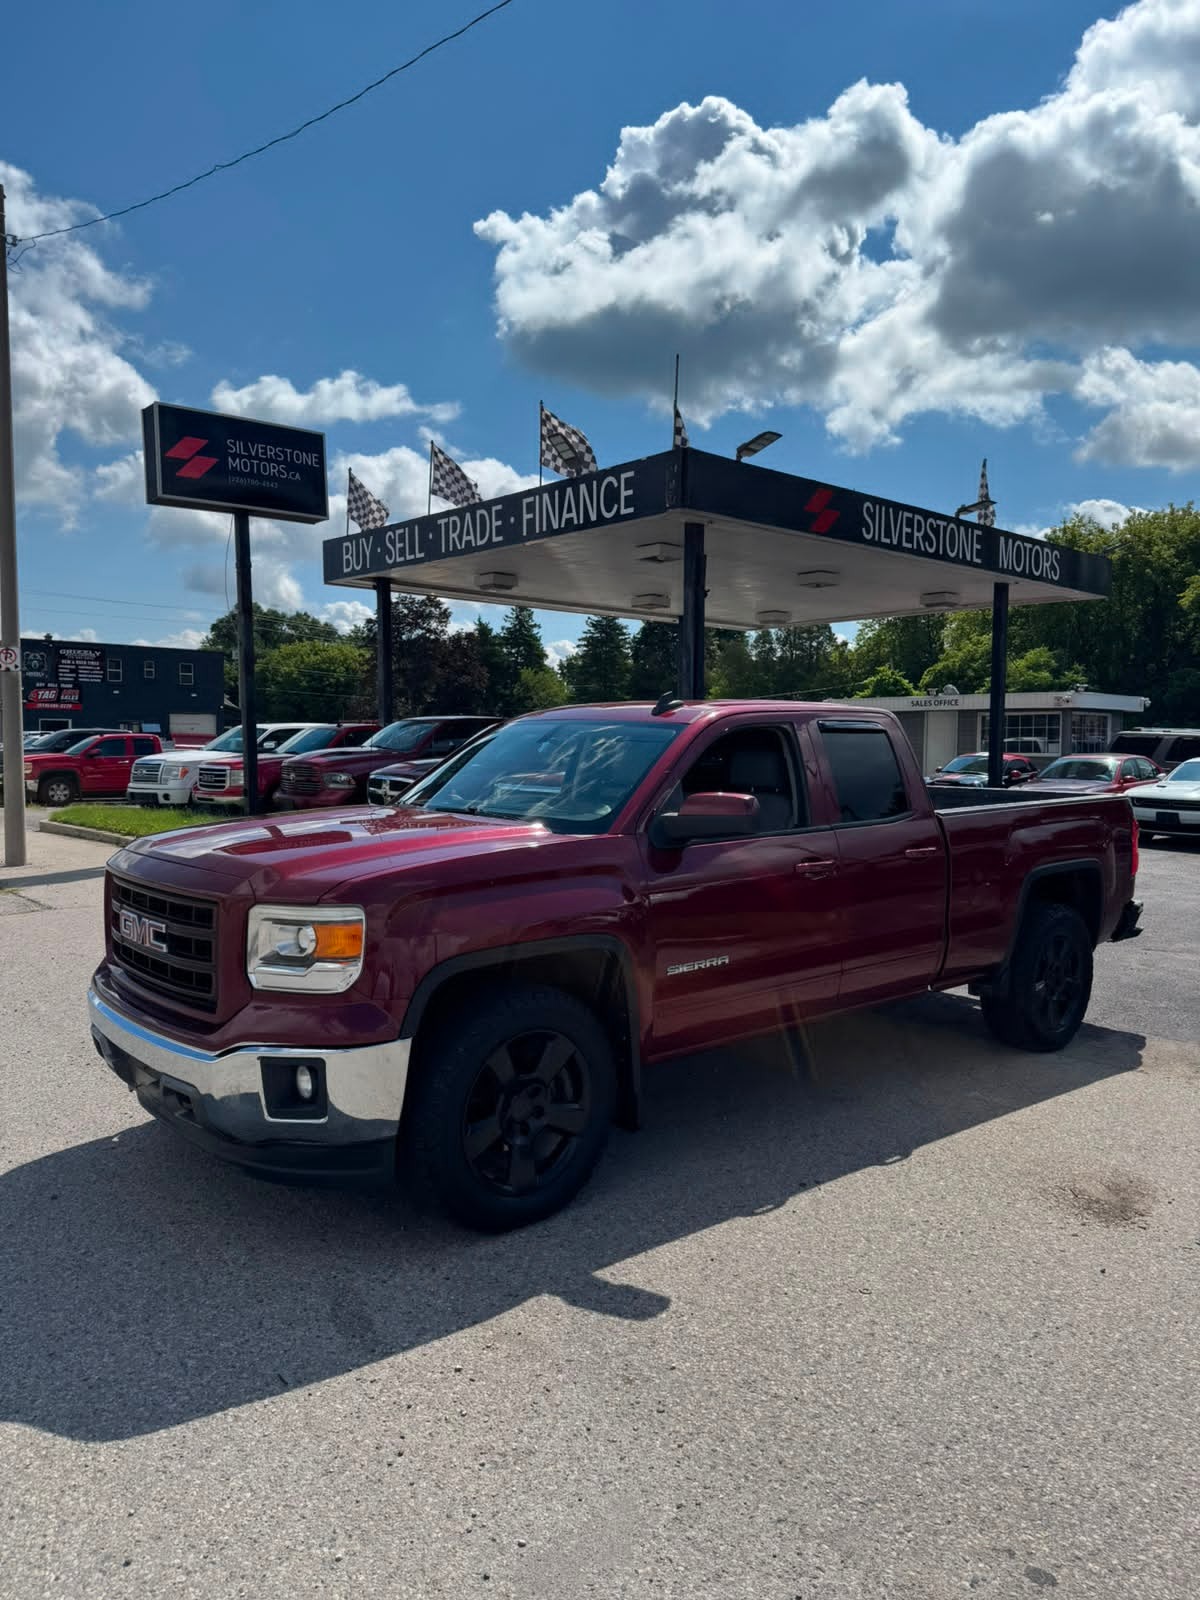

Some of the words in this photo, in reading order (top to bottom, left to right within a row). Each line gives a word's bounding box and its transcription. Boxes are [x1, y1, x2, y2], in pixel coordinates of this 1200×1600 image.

[226, 439, 321, 468] SILVERSTONE
[227, 456, 301, 481] MOTORS.CA
[342, 535, 374, 574] BUY
[385, 524, 425, 565] SELL
[437, 504, 504, 553] TRADE
[521, 470, 635, 537] FINANCE
[861, 501, 983, 564] SILVERSTONE
[999, 535, 1061, 581] MOTORS
[37, 690, 57, 699] TAG
[119, 909, 168, 953] GMC
[666, 955, 729, 976] SIERRA
